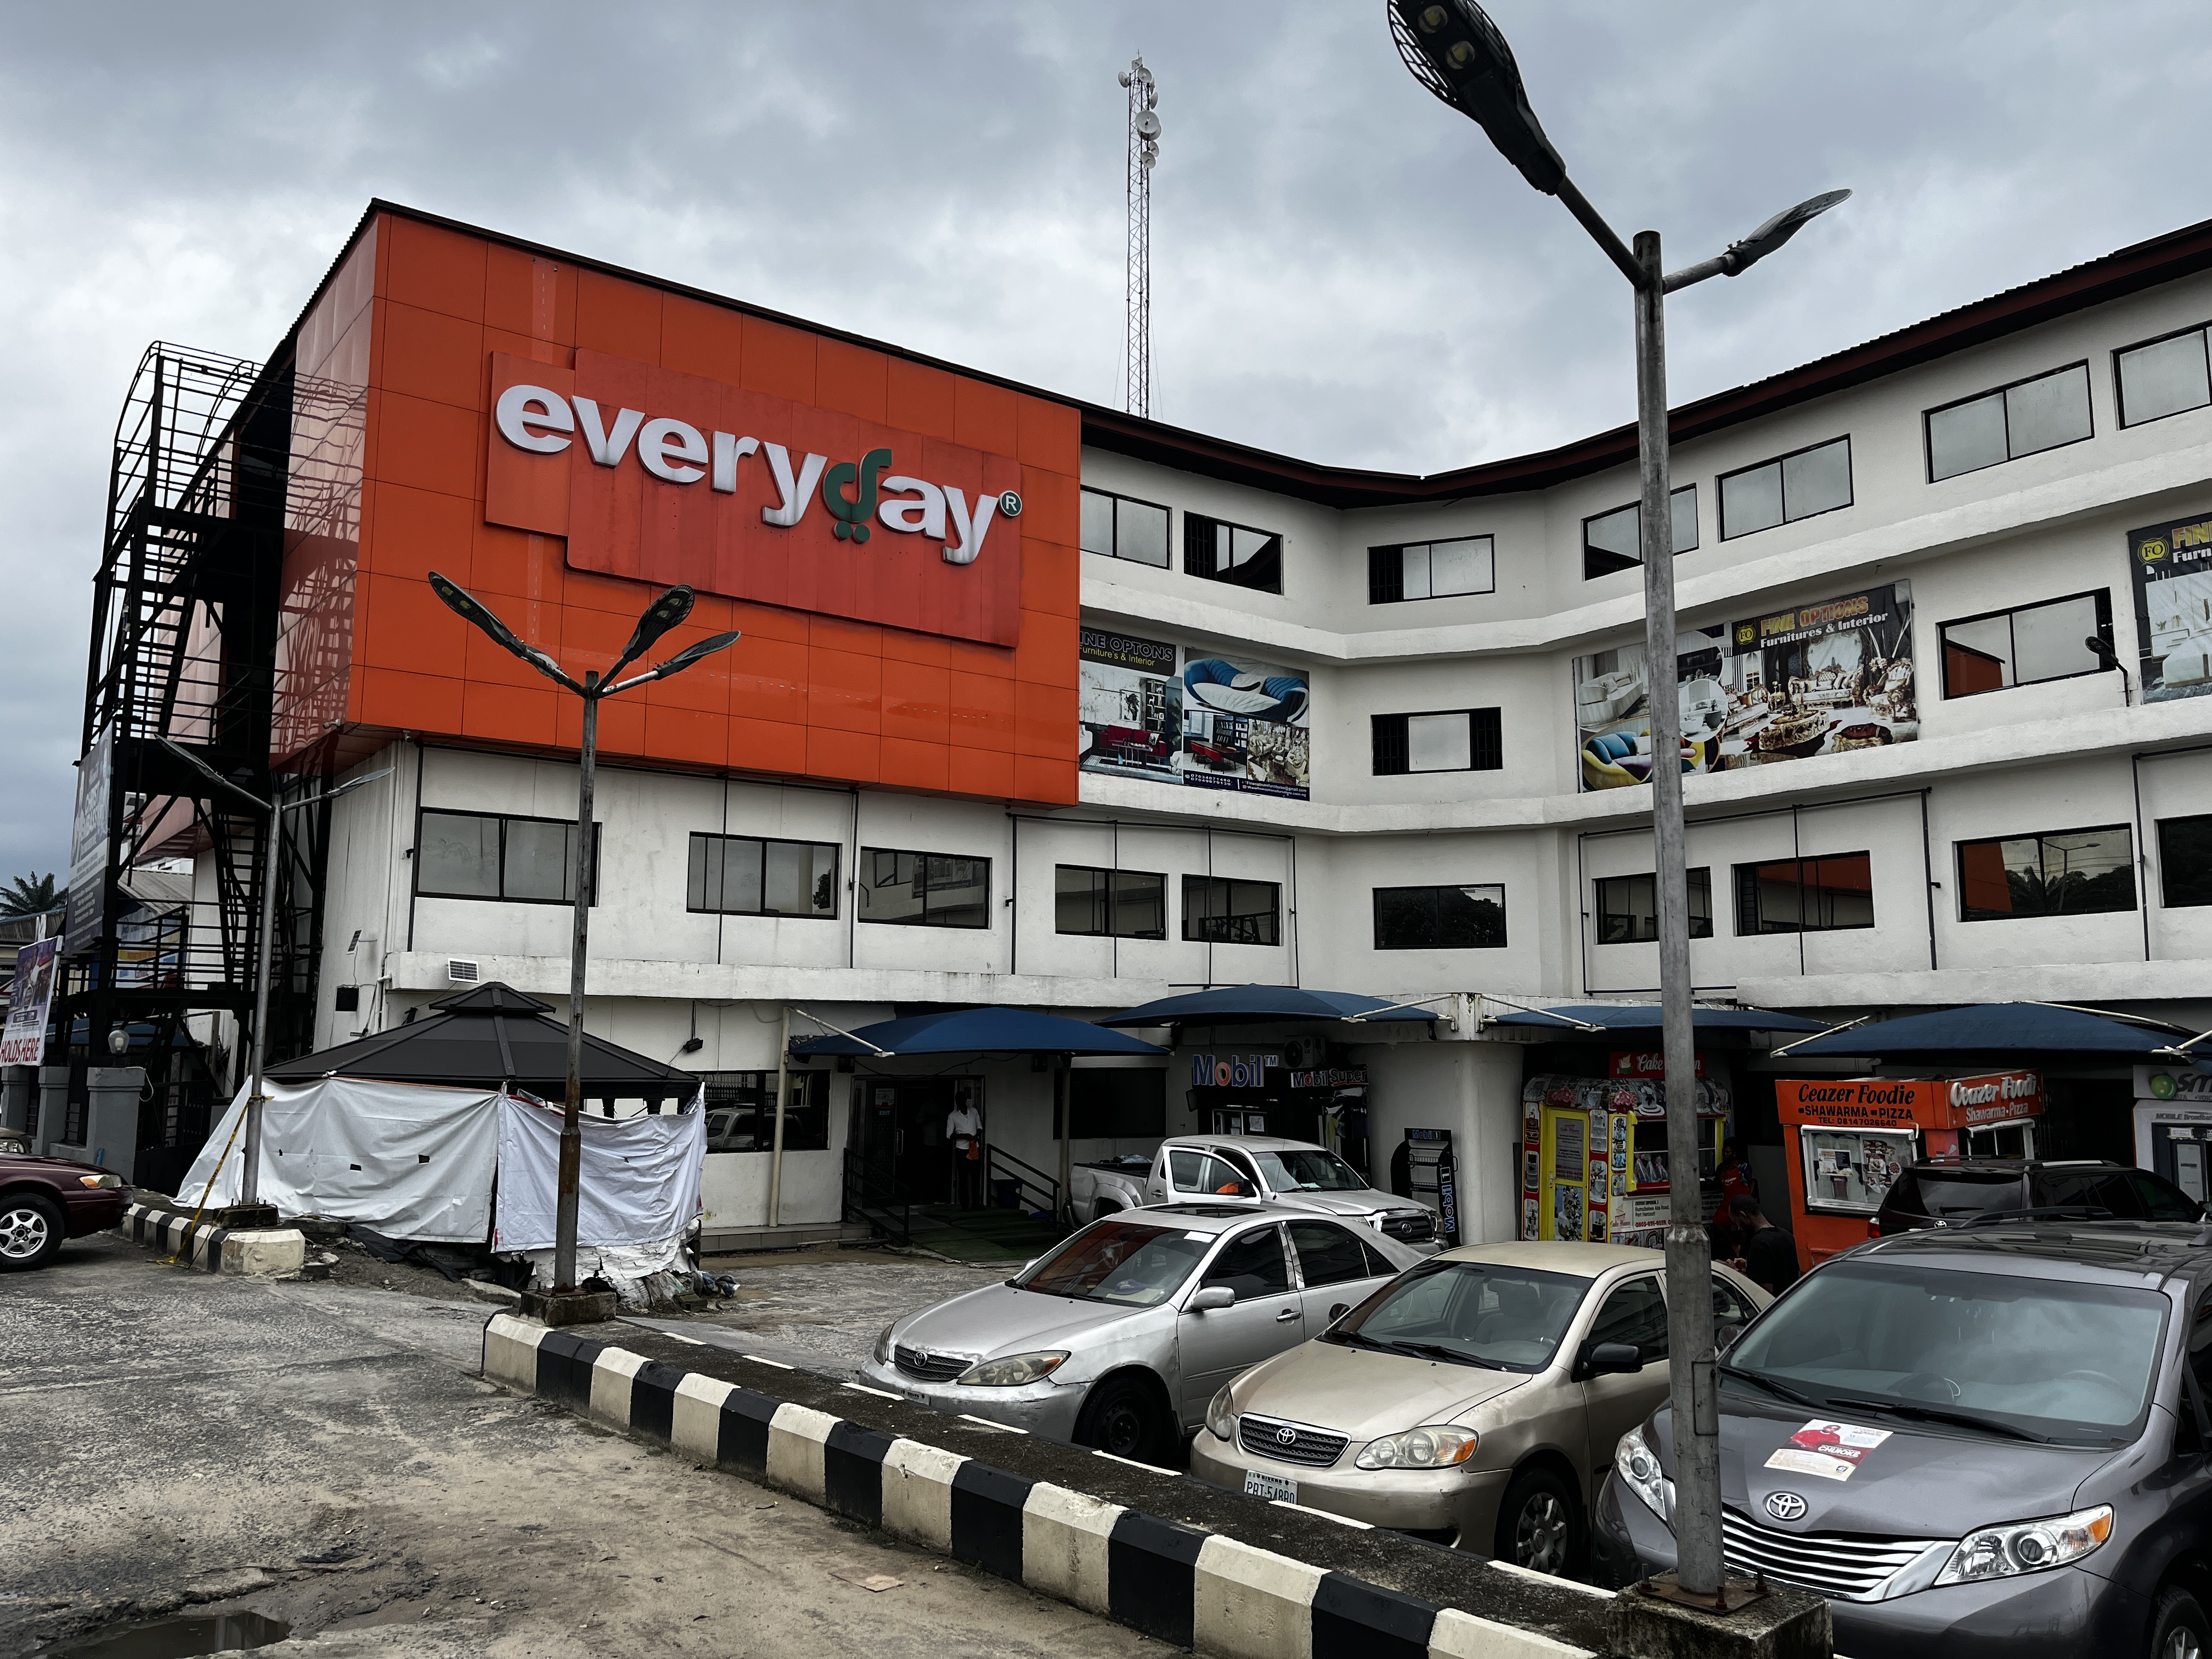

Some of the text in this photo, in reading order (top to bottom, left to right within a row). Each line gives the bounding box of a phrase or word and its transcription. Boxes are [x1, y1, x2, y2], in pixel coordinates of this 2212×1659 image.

[495, 384, 998, 565] everyday
[2144, 544, 2164, 558] FO
[1760, 596, 1869, 637] FINE OPTIONS
[1740, 630, 1753, 640] FO
[1760, 612, 1888, 648] Furnitures & Interior
[1079, 631, 1173, 662] INE OPTONS
[1121, 652, 1127, 661] &
[1128, 654, 1155, 667] Interior
[19, 1037, 41, 1062] HERE
[1193, 1054, 1279, 1088] Mobil TM
[1636, 1052, 1663, 1073] Cake
[1290, 1068, 1367, 1088] Mobil Super
[1798, 1084, 1915, 1105] Ceazer Foodie
[1950, 1081, 2000, 1108] Ceazer
[1805, 1104, 1914, 1120] SHAWARMA PIZZA
[1966, 1102, 2028, 1122] Shawarma Pizza
[1412, 1129, 1433, 1140] Mobil
[1442, 1184, 1455, 1233] Mobil
